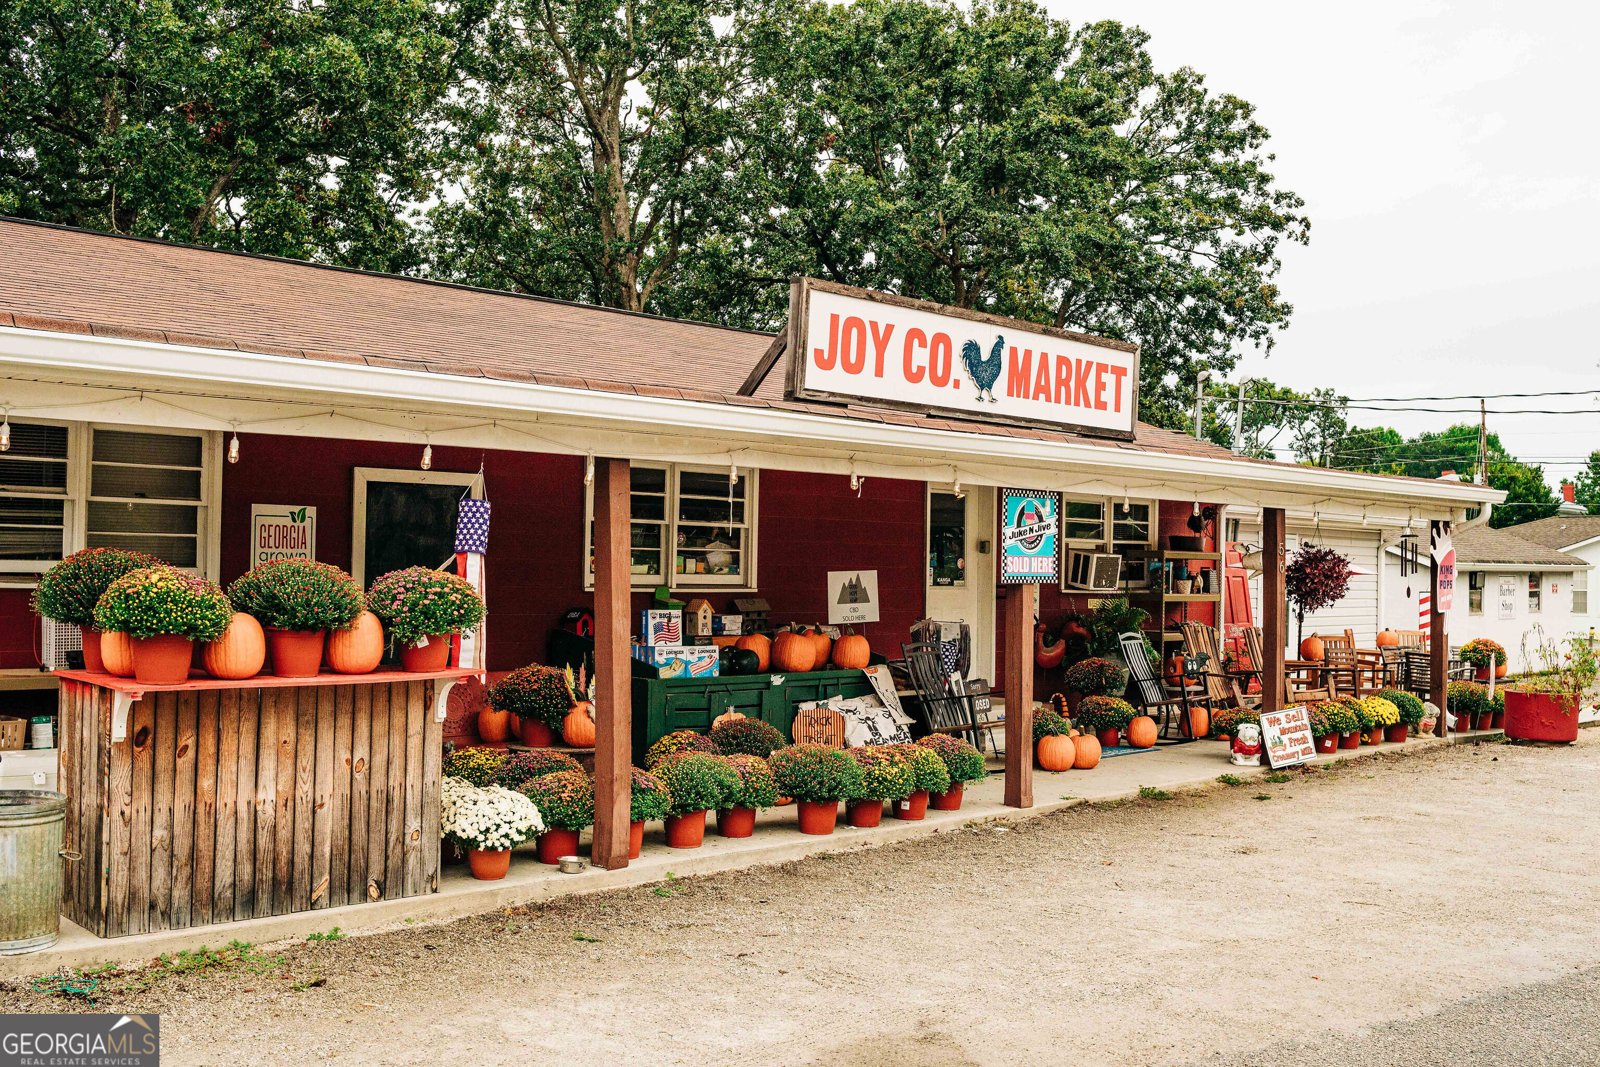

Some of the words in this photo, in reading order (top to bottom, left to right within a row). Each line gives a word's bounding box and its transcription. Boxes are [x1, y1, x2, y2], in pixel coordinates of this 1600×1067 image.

[814, 313, 895, 378] JOY
[903, 327, 960, 390] CO.
[1007, 346, 1127, 413] MARKET
[260, 524, 306, 549] GEORGIA
[1009, 528, 1028, 540] Juke
[1028, 526, 1034, 536] N
[1035, 522, 1052, 533] Jive
[1007, 556, 1030, 574] SOLD
[1031, 556, 1055, 574] HERE
[1440, 565, 1453, 575] KING
[1440, 580, 1453, 589] POPS
[1500, 585, 1515, 597] Barber
[1501, 599, 1514, 613] Shop
[975, 698, 990, 711] OSED
[803, 715, 832, 729] TRICK
[1265, 715, 1282, 728] We
[1284, 709, 1305, 724] Sell
[1279, 721, 1309, 736] Mountain
[1287, 733, 1309, 748] Fresh
[1272, 750, 1300, 762] Creamery
